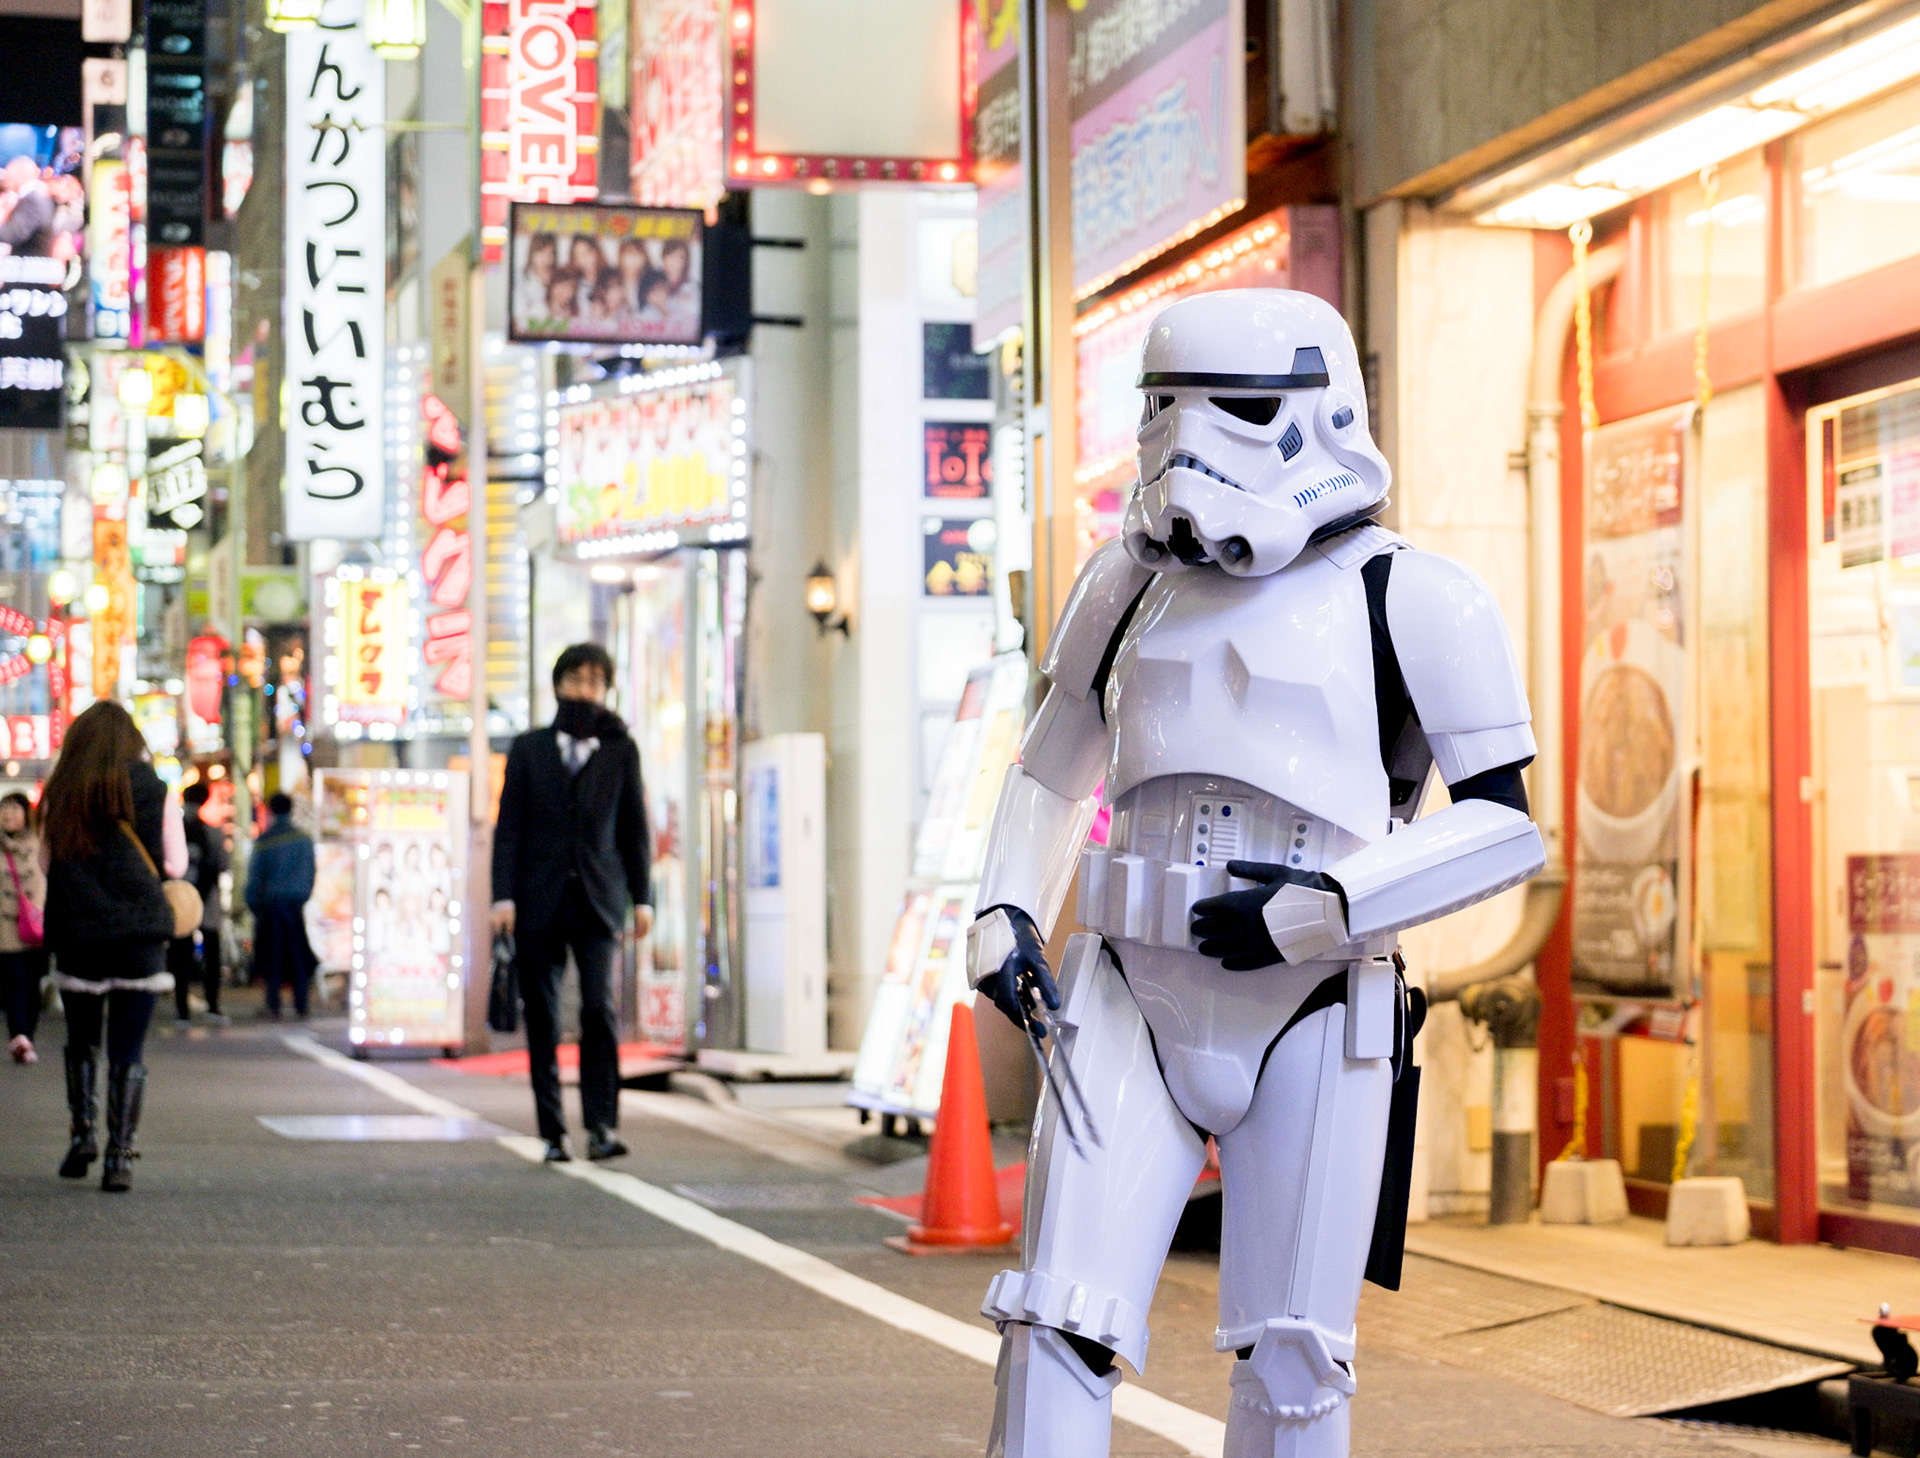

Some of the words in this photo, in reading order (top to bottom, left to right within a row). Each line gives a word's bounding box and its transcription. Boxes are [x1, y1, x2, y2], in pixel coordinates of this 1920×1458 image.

[301, 22, 366, 500] んかつにいむら
